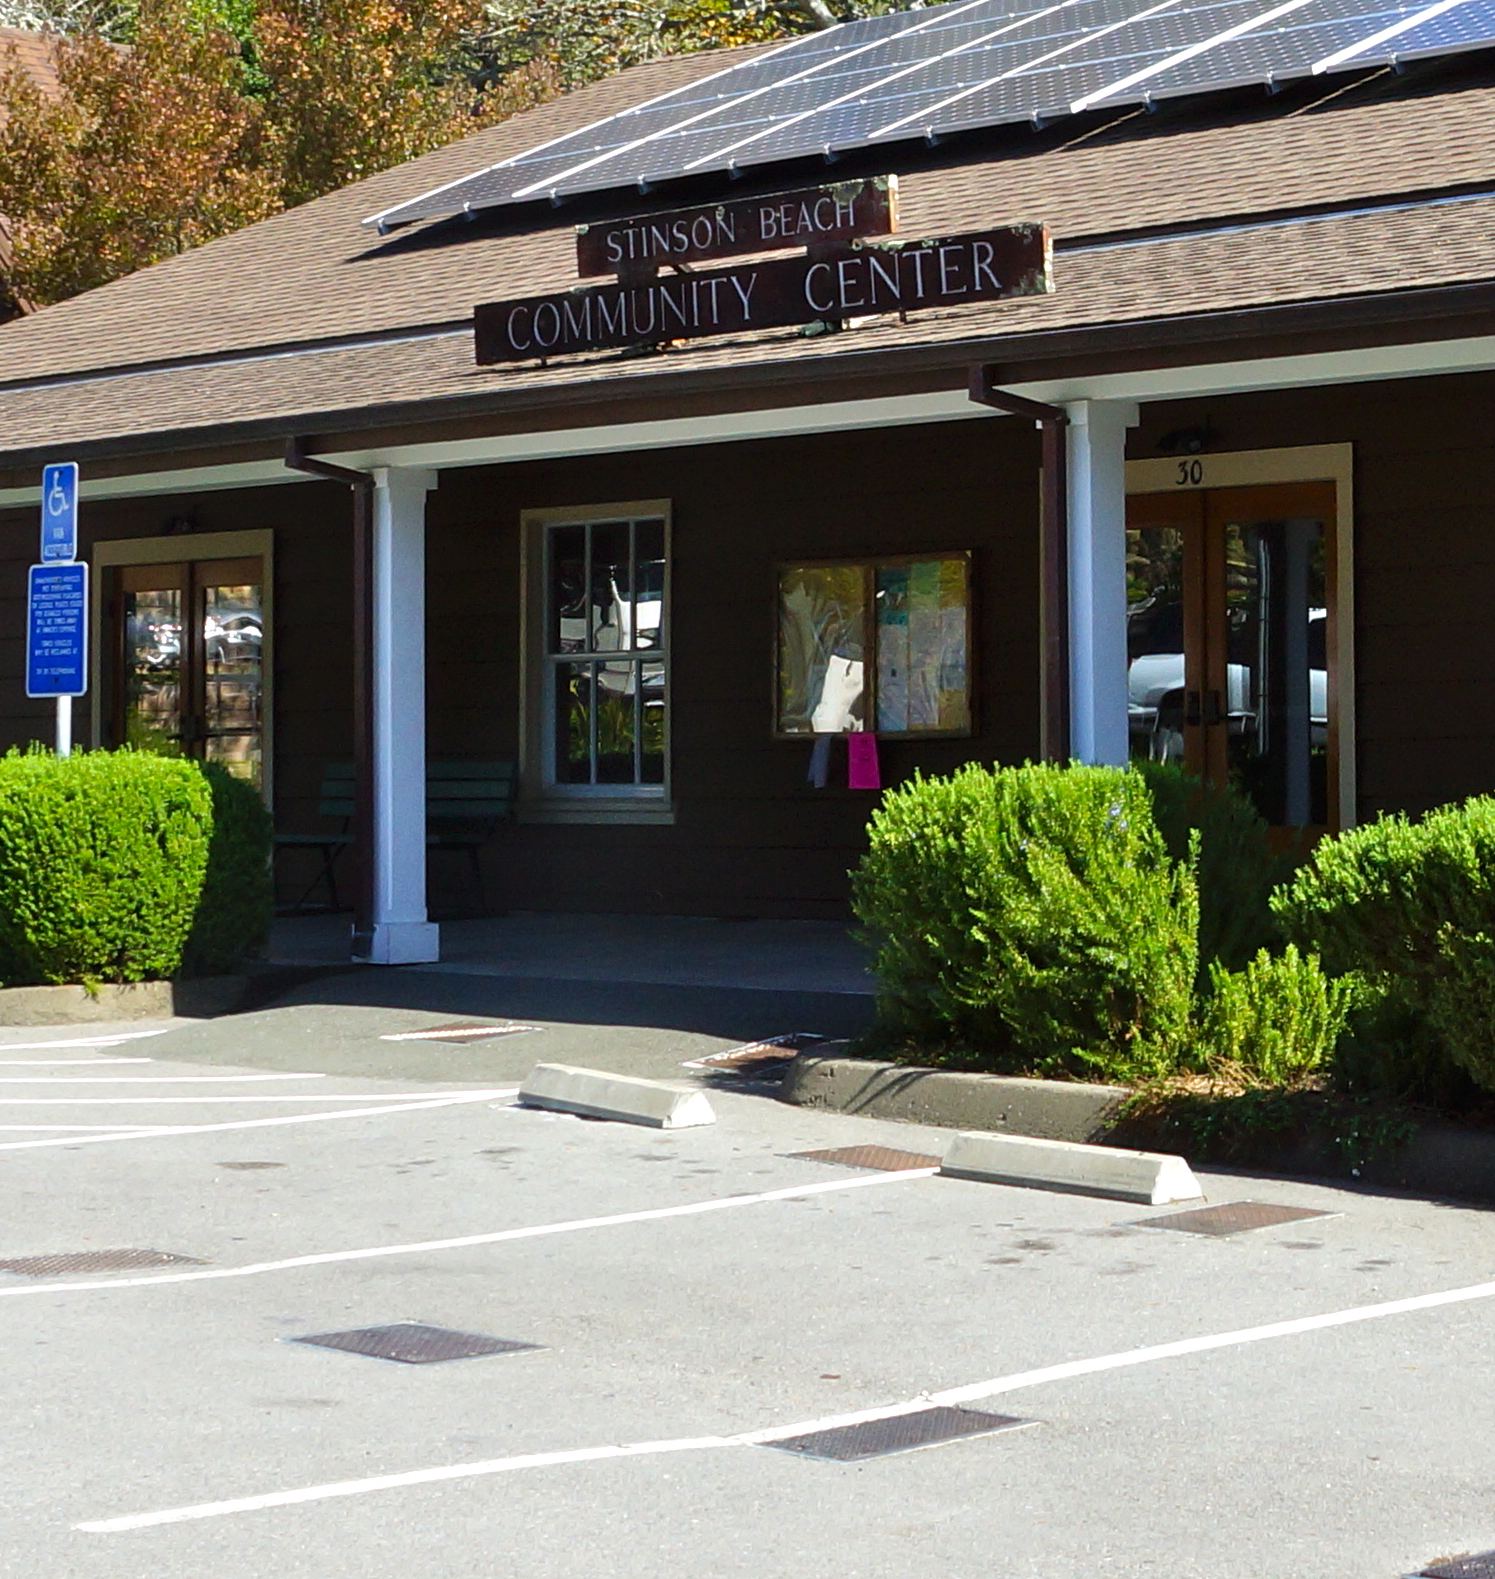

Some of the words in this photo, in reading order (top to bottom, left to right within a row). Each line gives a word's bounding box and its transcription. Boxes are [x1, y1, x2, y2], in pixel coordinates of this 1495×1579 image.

[606, 211, 736, 263] STINSON
[759, 196, 856, 241] BEACH
[506, 273, 758, 352] COMMUNITY
[804, 241, 1003, 312] CENTER
[1175, 459, 1202, 485] 30
